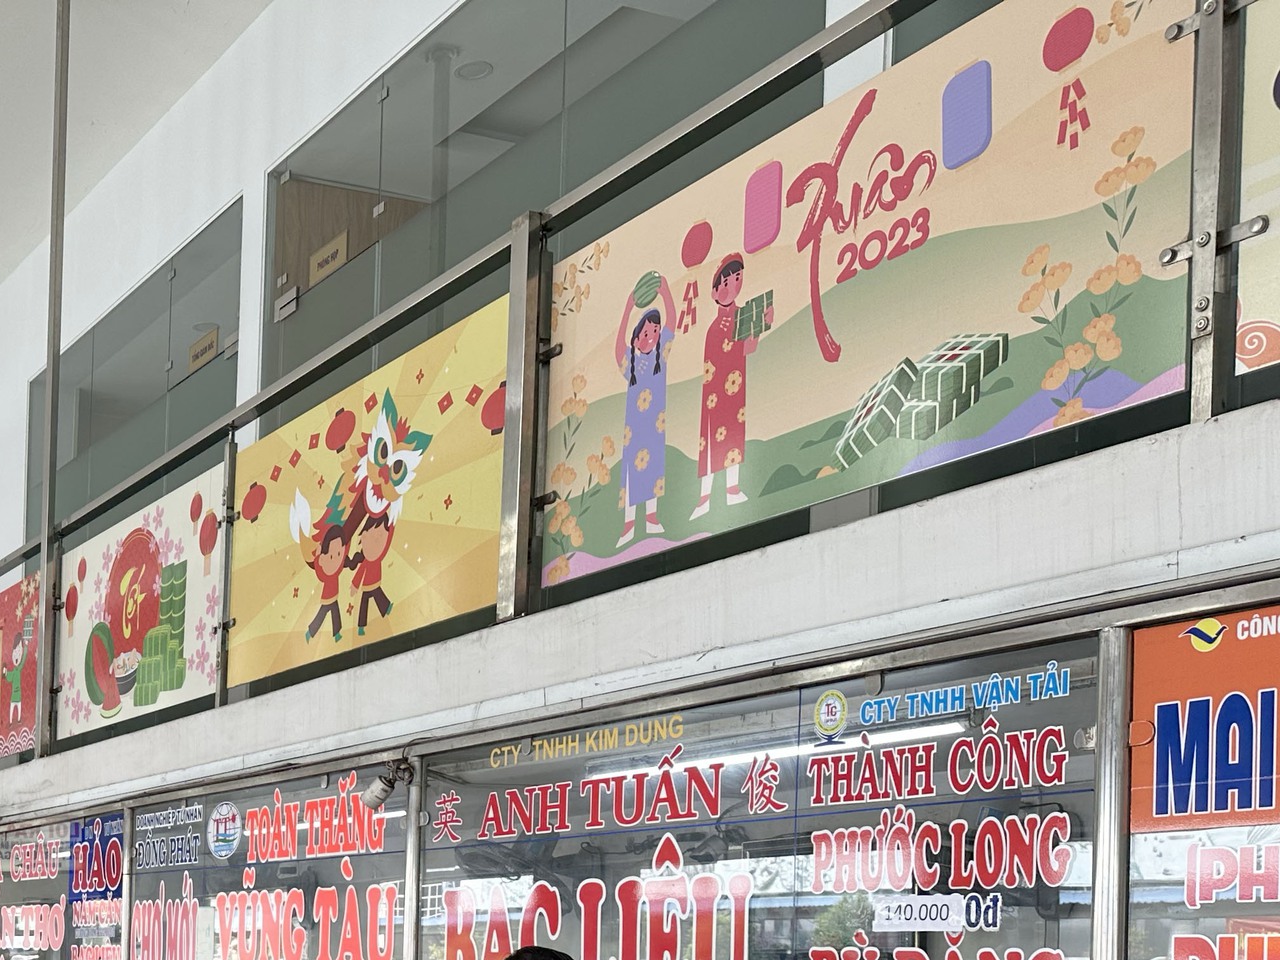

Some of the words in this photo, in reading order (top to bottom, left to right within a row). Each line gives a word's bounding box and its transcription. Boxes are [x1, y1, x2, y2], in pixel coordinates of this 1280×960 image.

[786, 88, 937, 363] Xuân
[837, 207, 931, 285] 2023
[860, 695, 902, 725] CTY
[905, 684, 967, 720] TNHH
[971, 672, 1021, 712] VẬN
[1026, 661, 1071, 700] TẢI
[490, 746, 522, 769] CTY
[532, 735, 580, 761] TNHH
[586, 728, 619, 753] KIM
[625, 715, 683, 746] DUNG
[807, 731, 938, 806] THÀNH
[947, 714, 1069, 794] CÔNG
[1153, 688, 1277, 817] MAI
[243, 788, 299, 863] TOÀN
[304, 771, 385, 857] THẮNG
[432, 790, 463, 842] 英
[477, 781, 572, 841] ANH
[580, 742, 724, 829] TUẤN
[10, 831, 60, 882] CHÂU
[72, 818, 123, 893] HẢO
[136, 829, 167, 869] ĐỒNG
[169, 825, 201, 865] PHÁT
[811, 804, 941, 894] PHƯỚC
[948, 812, 1072, 890] LONG
[20, 894, 66, 951] THƠ
[884, 902, 950, 921] 140.000
[964, 893, 1002, 931] 0đ
